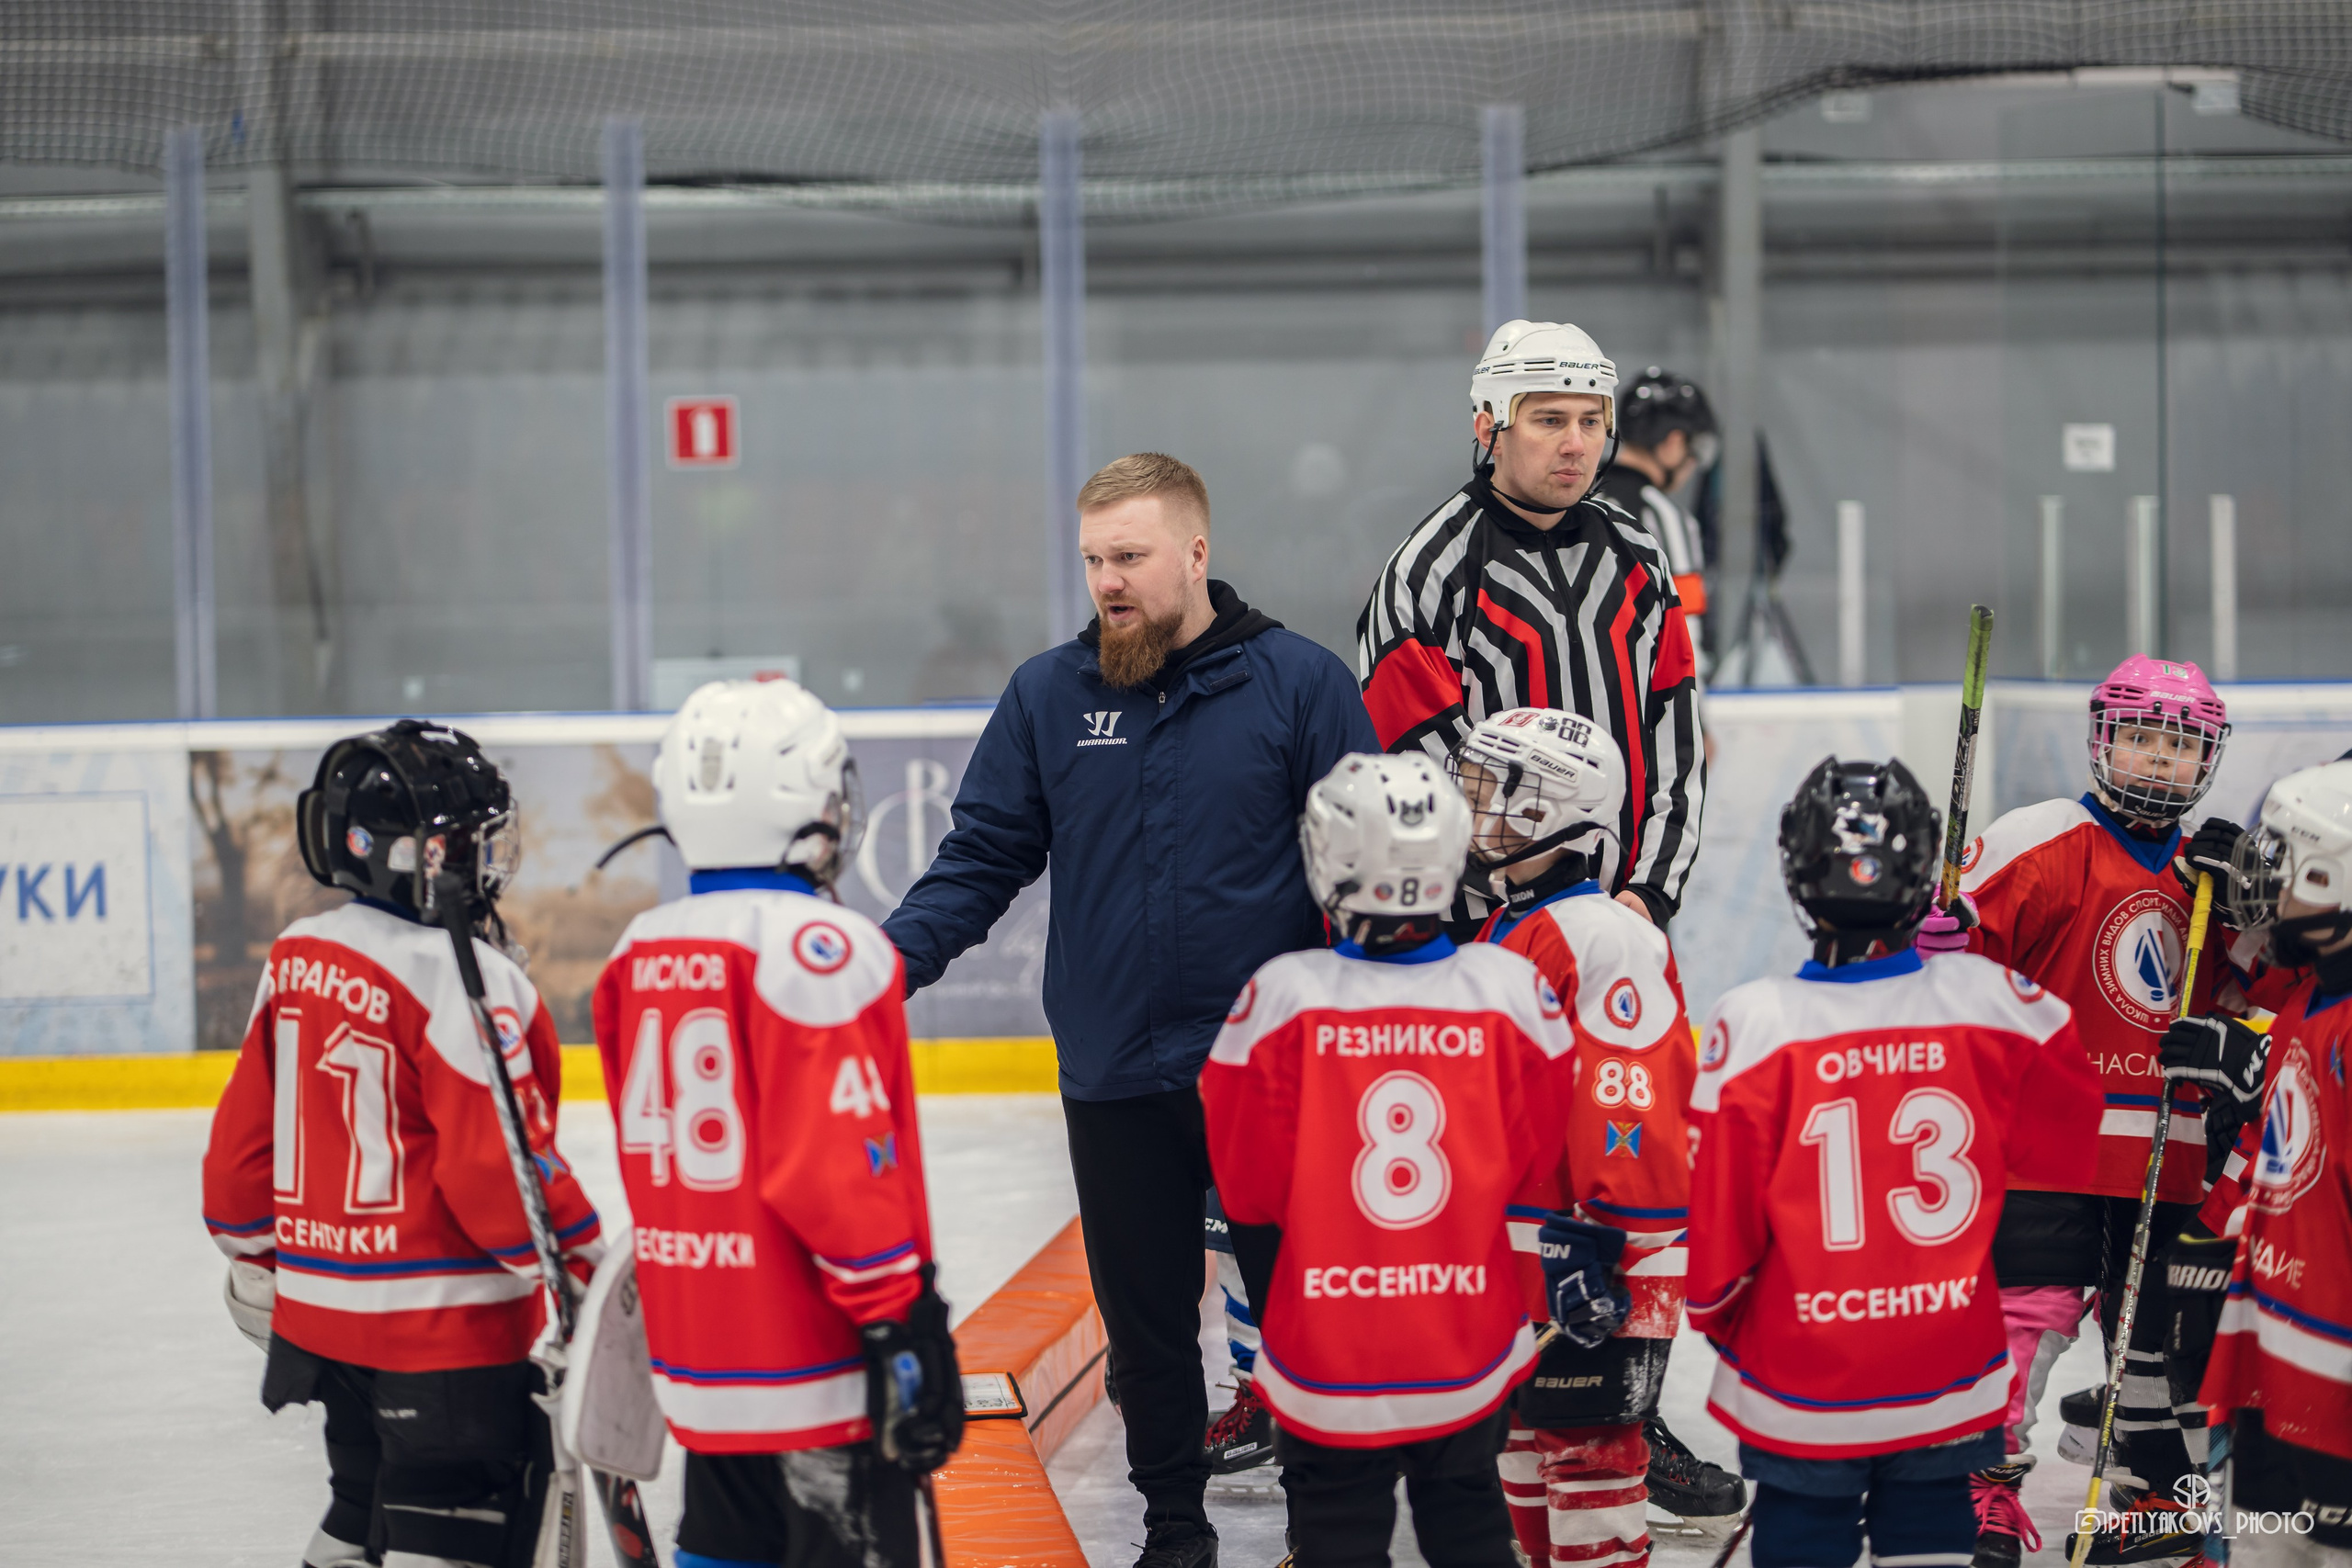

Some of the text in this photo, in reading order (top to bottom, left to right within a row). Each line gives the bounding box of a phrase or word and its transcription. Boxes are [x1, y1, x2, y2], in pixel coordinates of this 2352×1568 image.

[1559, 361, 1600, 370] BAUER
[2150, 691, 2196, 704] BAUER
[1530, 754, 1576, 779] BAUER
[1400, 877, 1419, 907] 8
[2129, 897, 2161, 913] СПОРТ
[2101, 910, 2130, 946] ВИДОВ
[2099, 948, 2119, 995] ЗИМНИХ
[1316, 1023, 1486, 1058] РЕЗНИКОВ
[1815, 1040, 1948, 1085] ОВЧИЕВ
[620, 1007, 747, 1193] 48
[1590, 1055, 1656, 1112] 88
[274, 1005, 405, 1216] 11
[1351, 1069, 1453, 1232] 8
[1799, 1086, 1982, 1252] 13
[1534, 1375, 1603, 1389] BAUER
